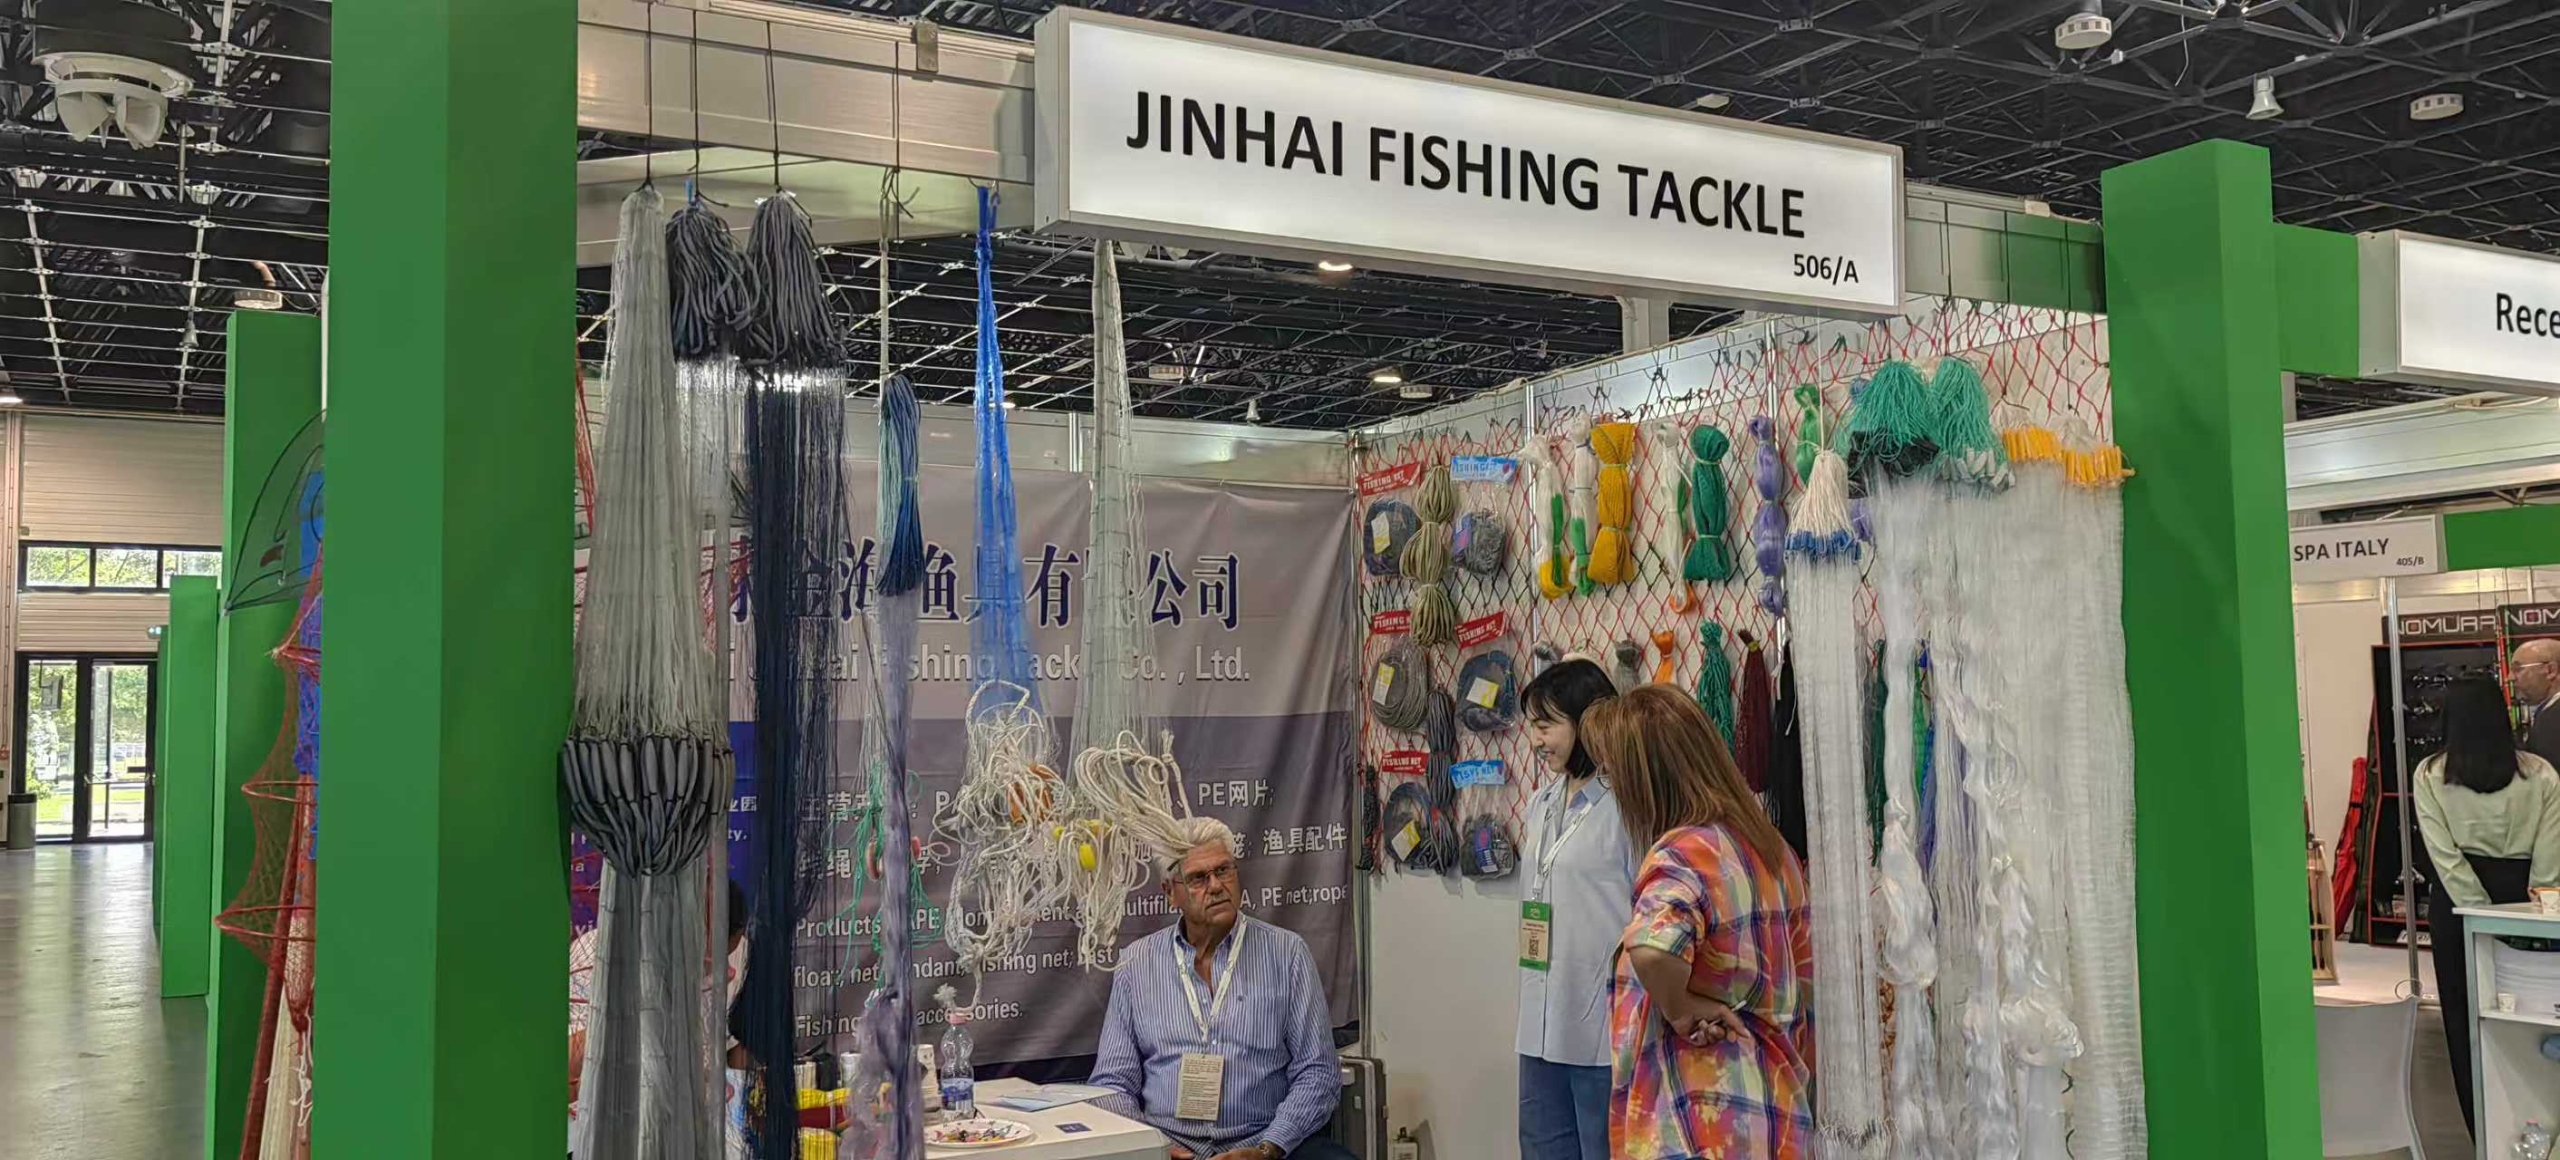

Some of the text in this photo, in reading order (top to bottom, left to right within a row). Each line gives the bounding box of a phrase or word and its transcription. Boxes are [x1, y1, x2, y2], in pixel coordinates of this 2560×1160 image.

[1126, 90, 1806, 239] JINHAI FISHING TACKLE
[1793, 253, 1860, 285] 506/A
[2496, 292, 2560, 339] Rece
[2293, 538, 2390, 562] SPA ITALY
[2396, 556, 2425, 567] 405/B
[1195, 644, 1251, 682] Ltd.
[1261, 886, 1283, 908] PE
[1042, 949, 1074, 968] net;
